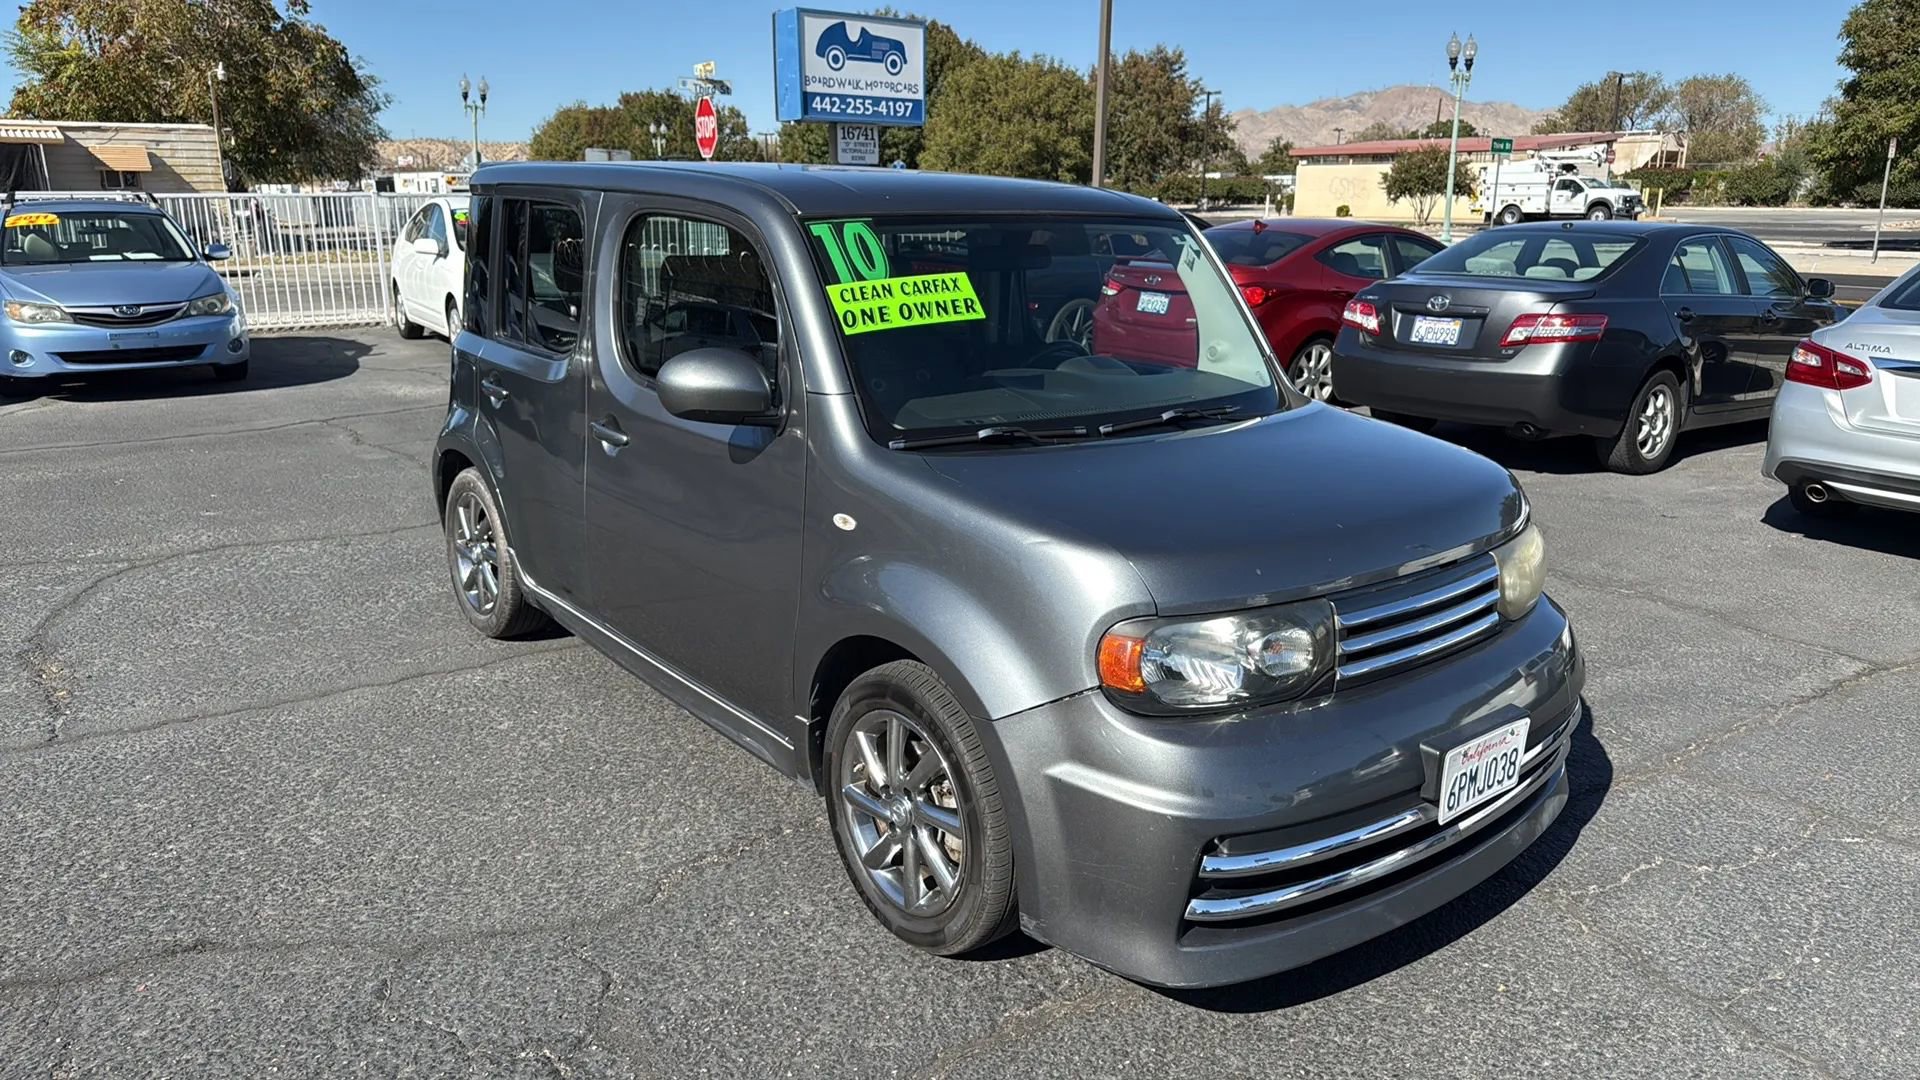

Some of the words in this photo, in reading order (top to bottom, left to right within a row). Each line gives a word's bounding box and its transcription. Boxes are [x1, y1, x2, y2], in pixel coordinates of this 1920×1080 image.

[865, 80, 920, 95] MOTORCARS
[812, 96, 913, 118] 442-255-4197
[697, 115, 715, 138] STOP
[840, 125, 875, 141] 16741
[809, 222, 889, 283] 10
[839, 283, 894, 304] CLEAN
[900, 277, 962, 297] CARFAX
[842, 305, 892, 329] ONE
[899, 297, 978, 322] OWNER
[1414, 325, 1457, 342] 6JPH998
[1845, 343, 1891, 353] ALTIMA
[1461, 736, 1511, 766] California
